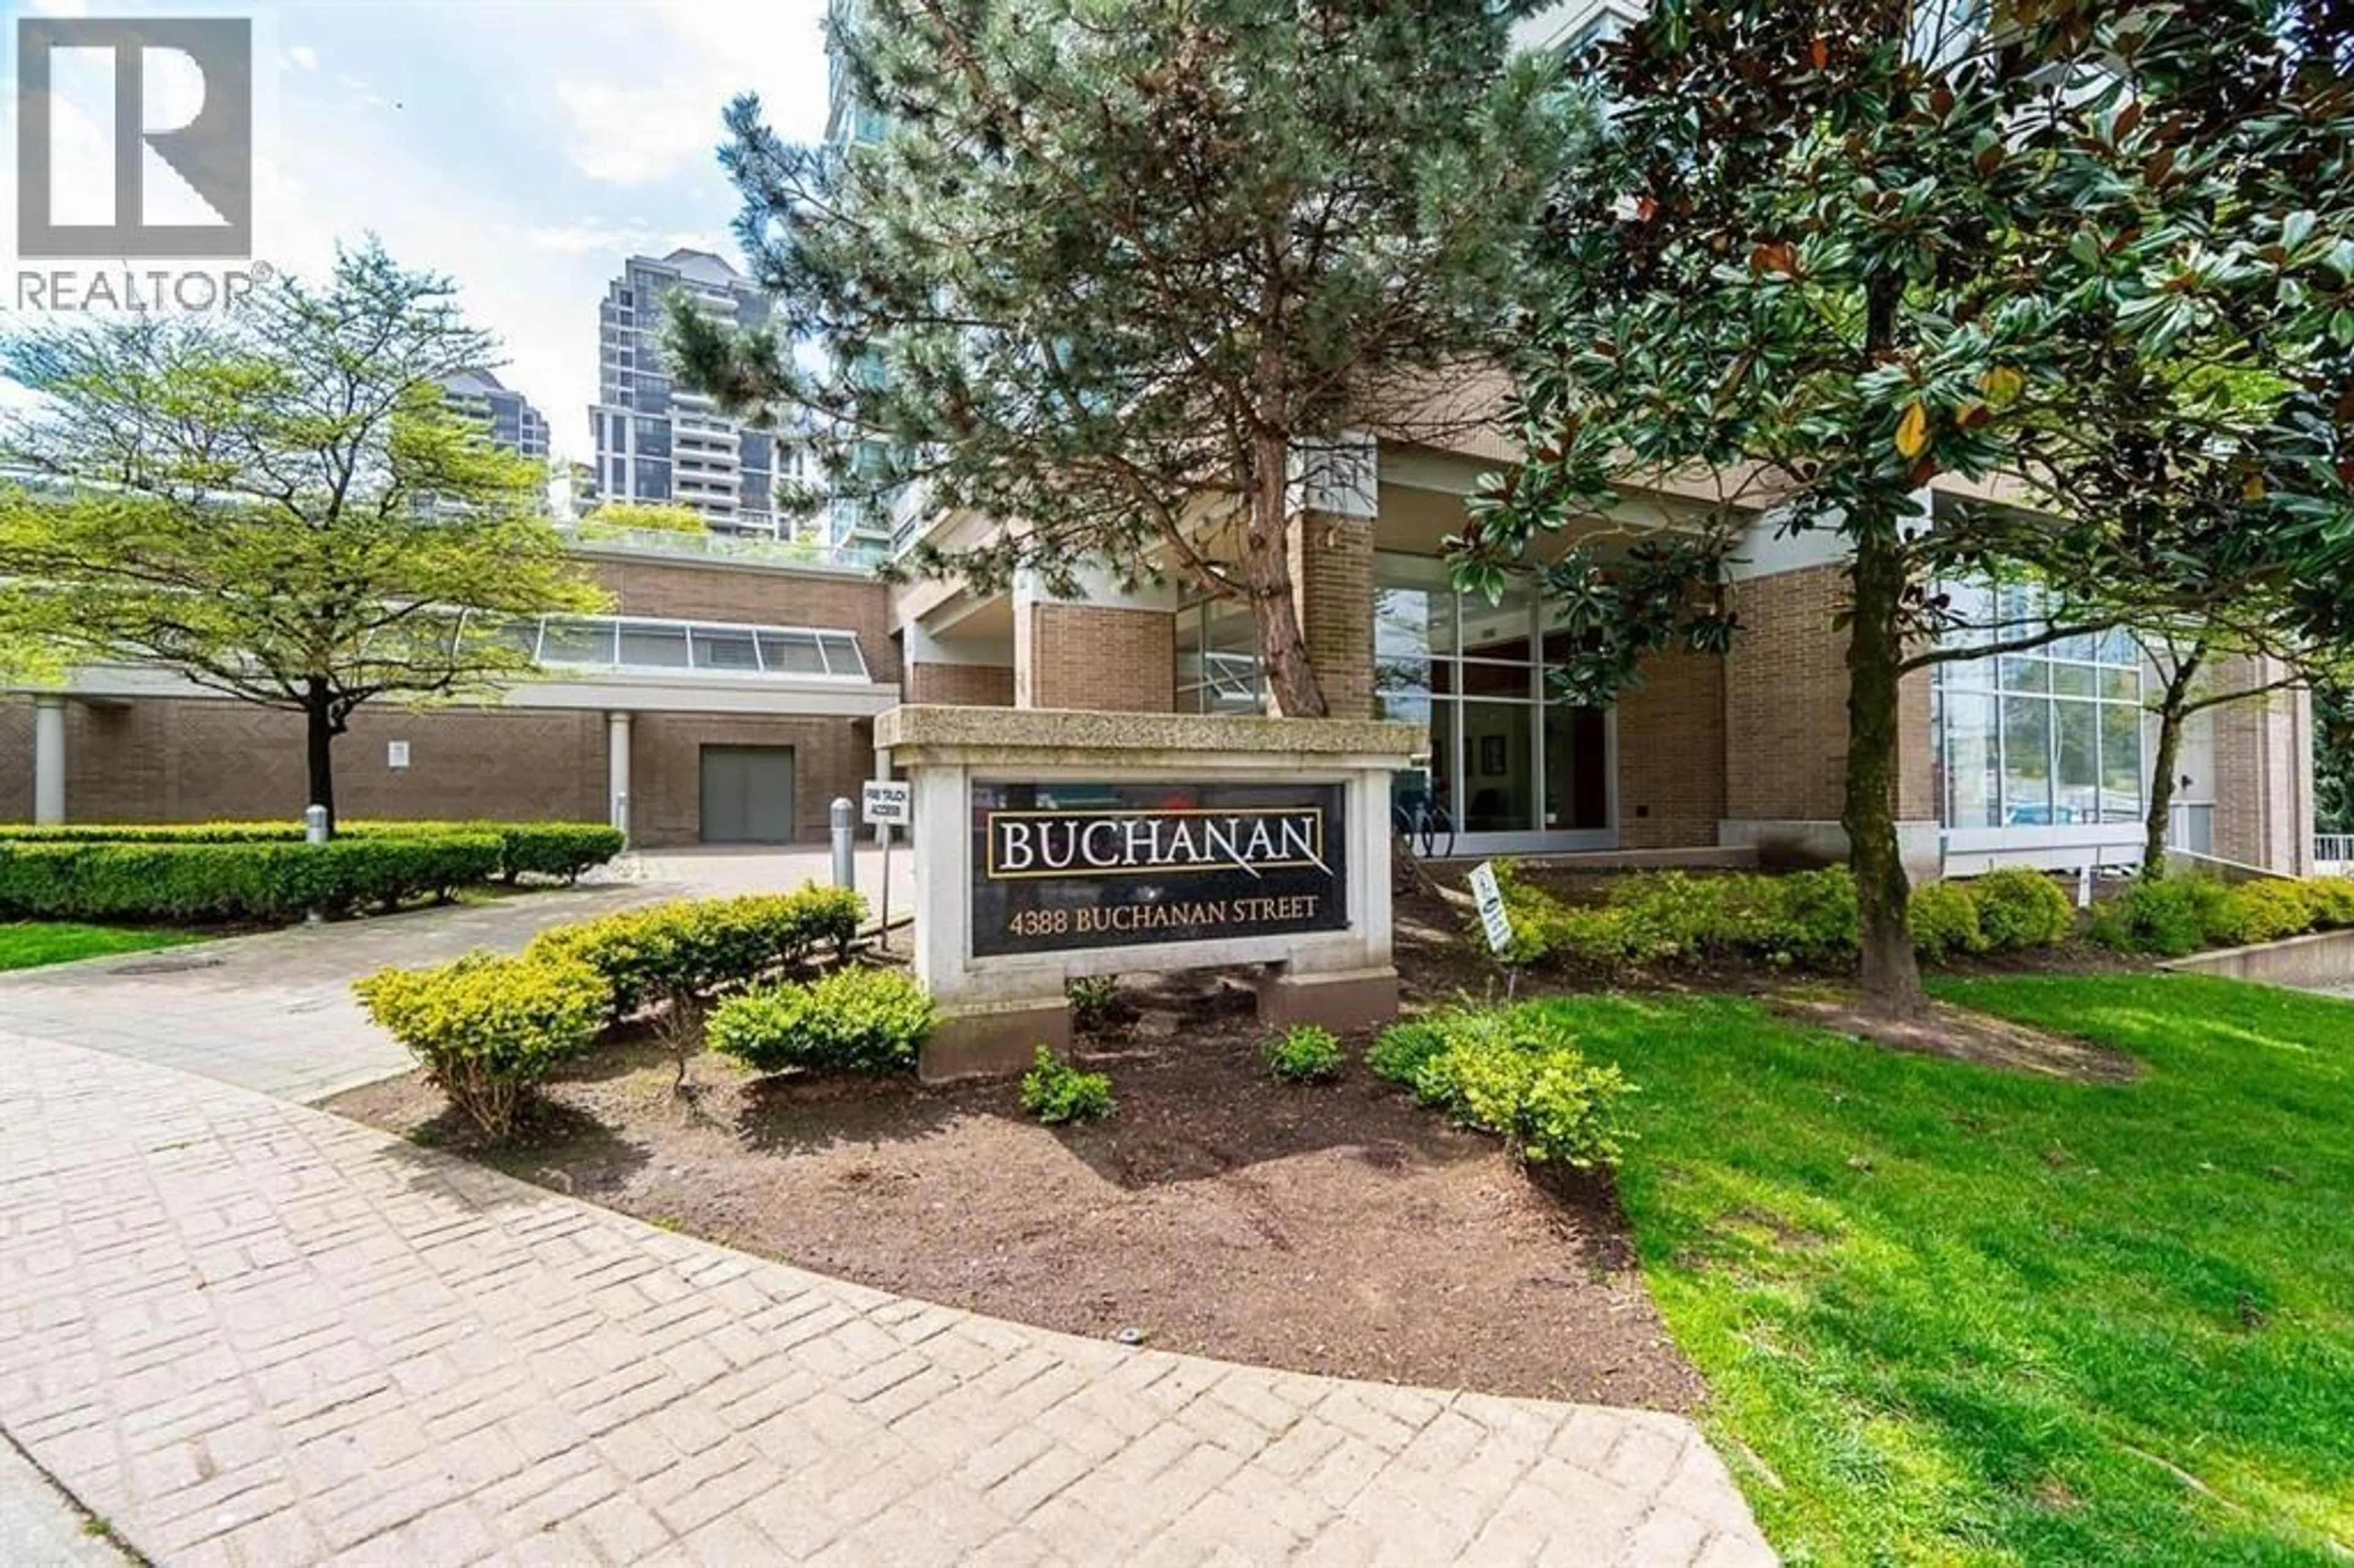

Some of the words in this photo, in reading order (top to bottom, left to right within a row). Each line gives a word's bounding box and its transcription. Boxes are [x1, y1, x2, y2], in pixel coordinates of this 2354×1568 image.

[999, 816, 1335, 878] BUCHANAN
[1008, 910, 1068, 936] 4388
[1076, 900, 1227, 932] BUCHANAN
[1233, 894, 1319, 921] STREET
